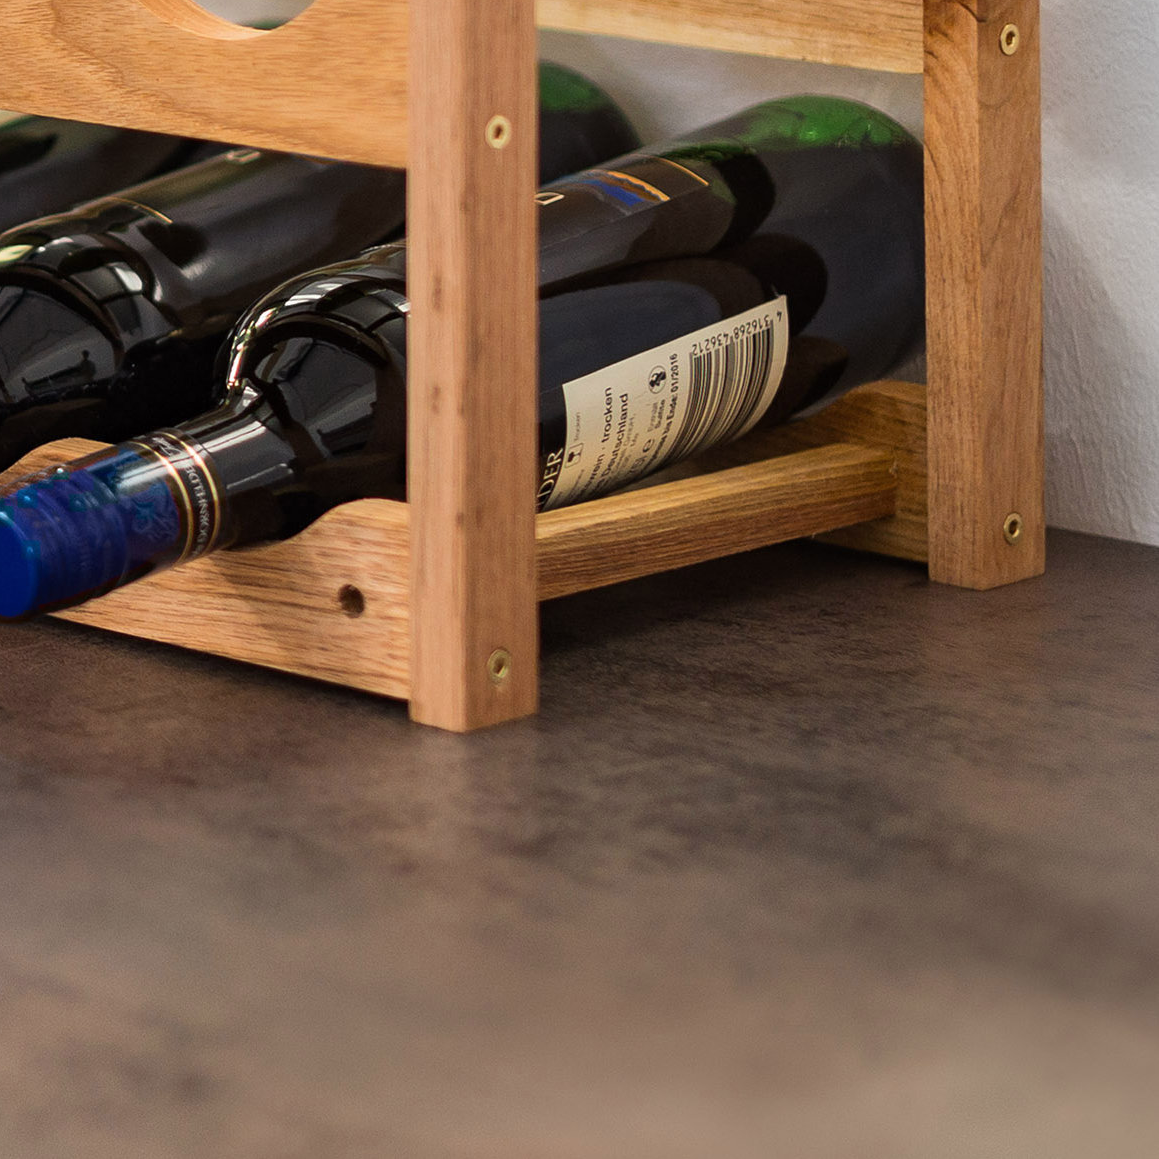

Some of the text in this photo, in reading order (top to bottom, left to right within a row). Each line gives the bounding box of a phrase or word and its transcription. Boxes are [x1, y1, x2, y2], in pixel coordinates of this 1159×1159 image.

[692, 310, 783, 356] 4 316268 436212
[668, 353, 680, 393] 01/2016
[601, 386, 613, 444] trocken
[601, 392, 630, 477] Deutschland
[185, 465, 210, 544] DORNFELDE
[535, 447, 564, 506] DER
